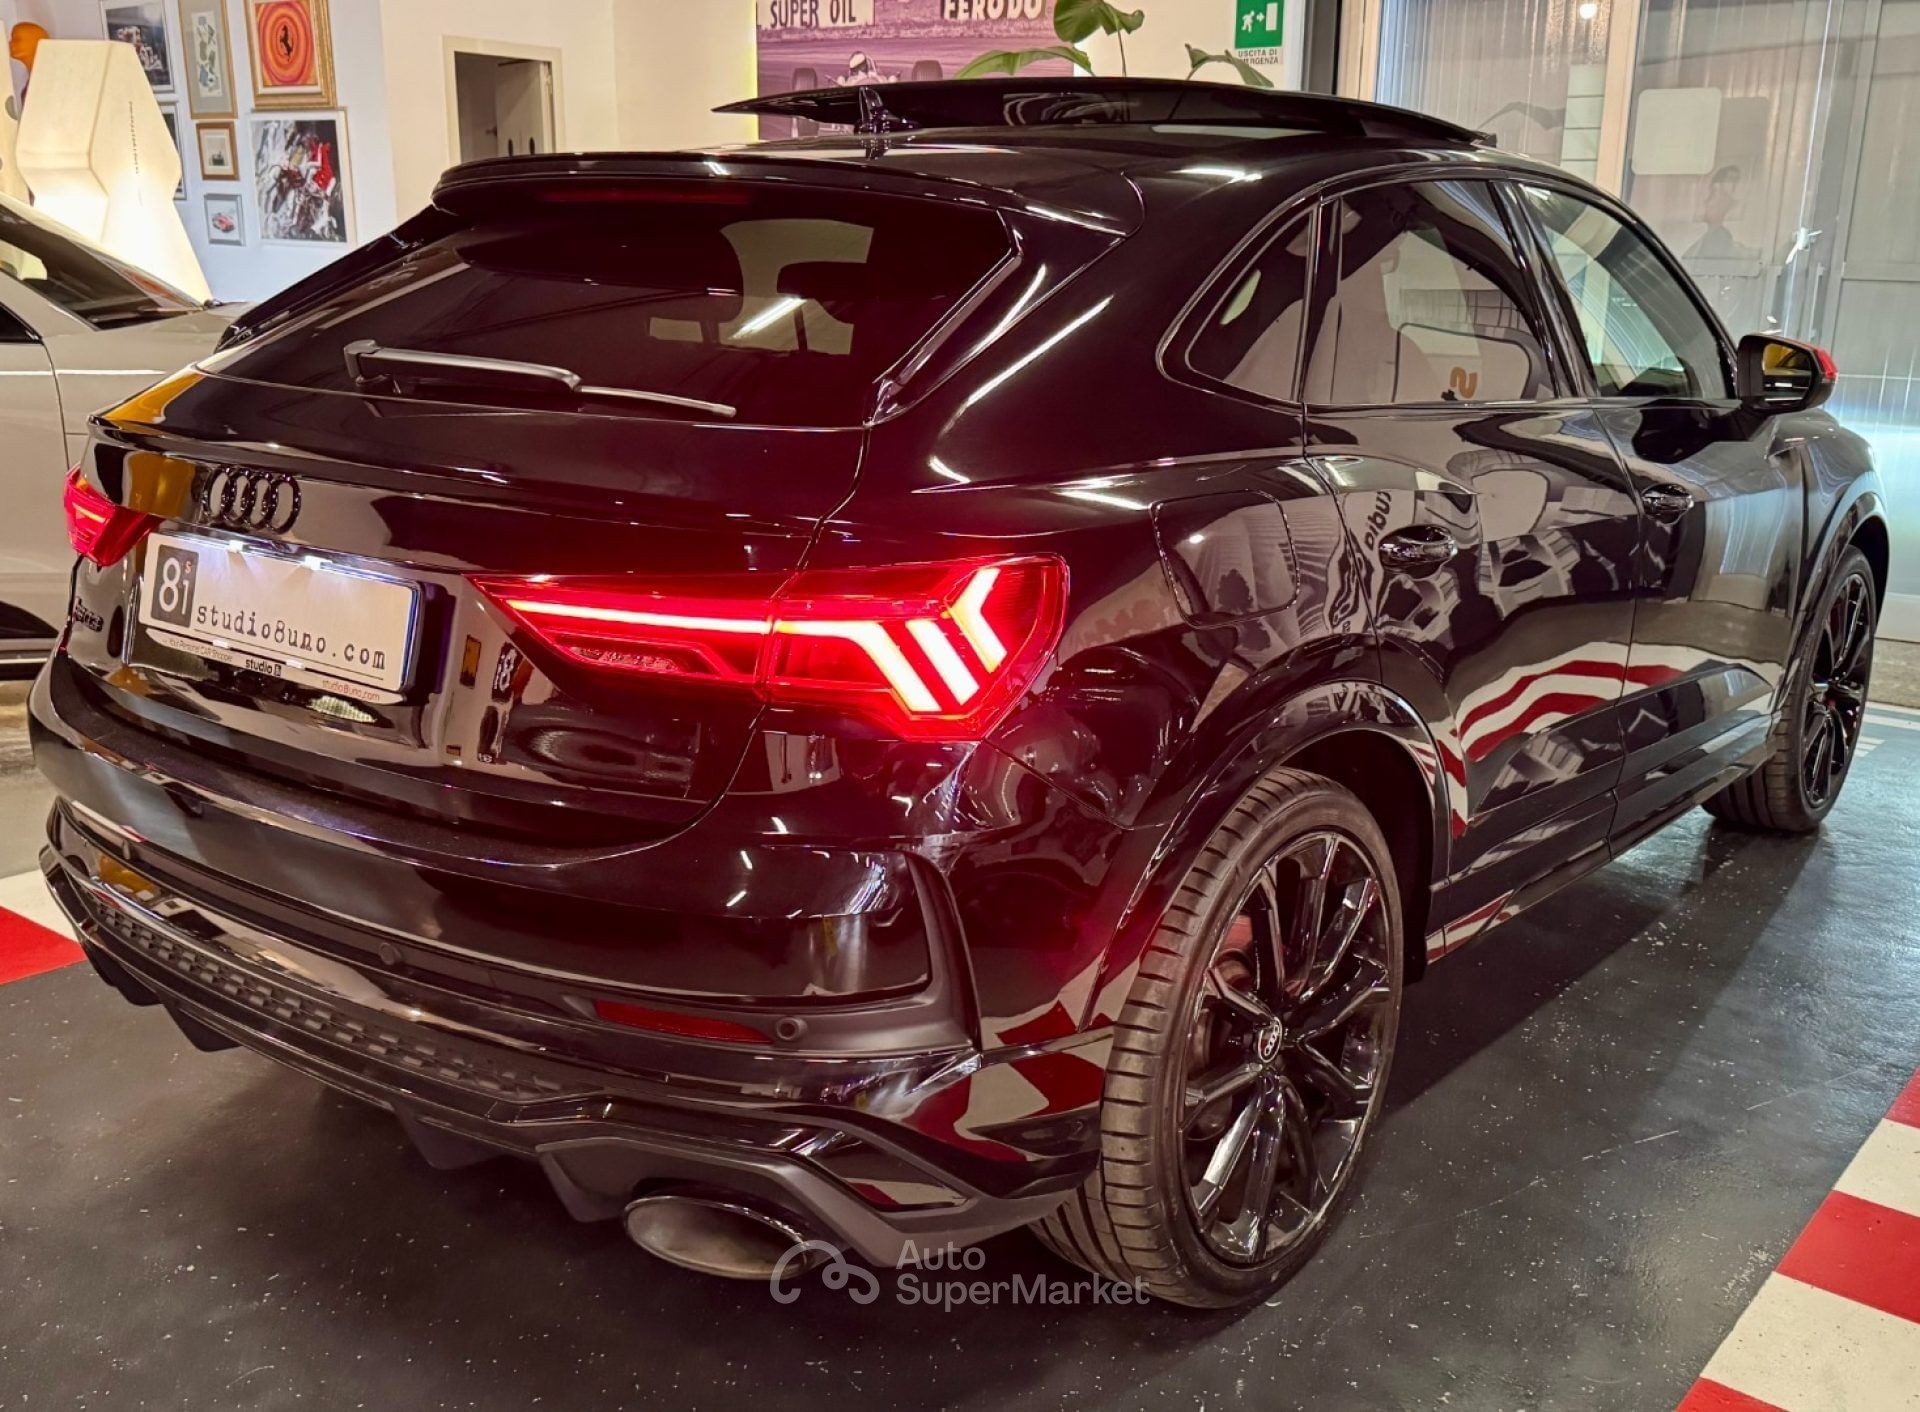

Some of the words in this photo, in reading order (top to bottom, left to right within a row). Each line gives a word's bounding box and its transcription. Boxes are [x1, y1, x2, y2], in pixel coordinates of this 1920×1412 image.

[770, 0, 819, 28] SUPER
[829, 0, 857, 23] OIL
[942, 0, 1043, 20] FERODO
[1238, 49, 1267, 57] USCITA
[1269, 48, 1278, 56] DI
[196, 604, 386, 670] studio8uno.com
[245, 658, 273, 675] studio
